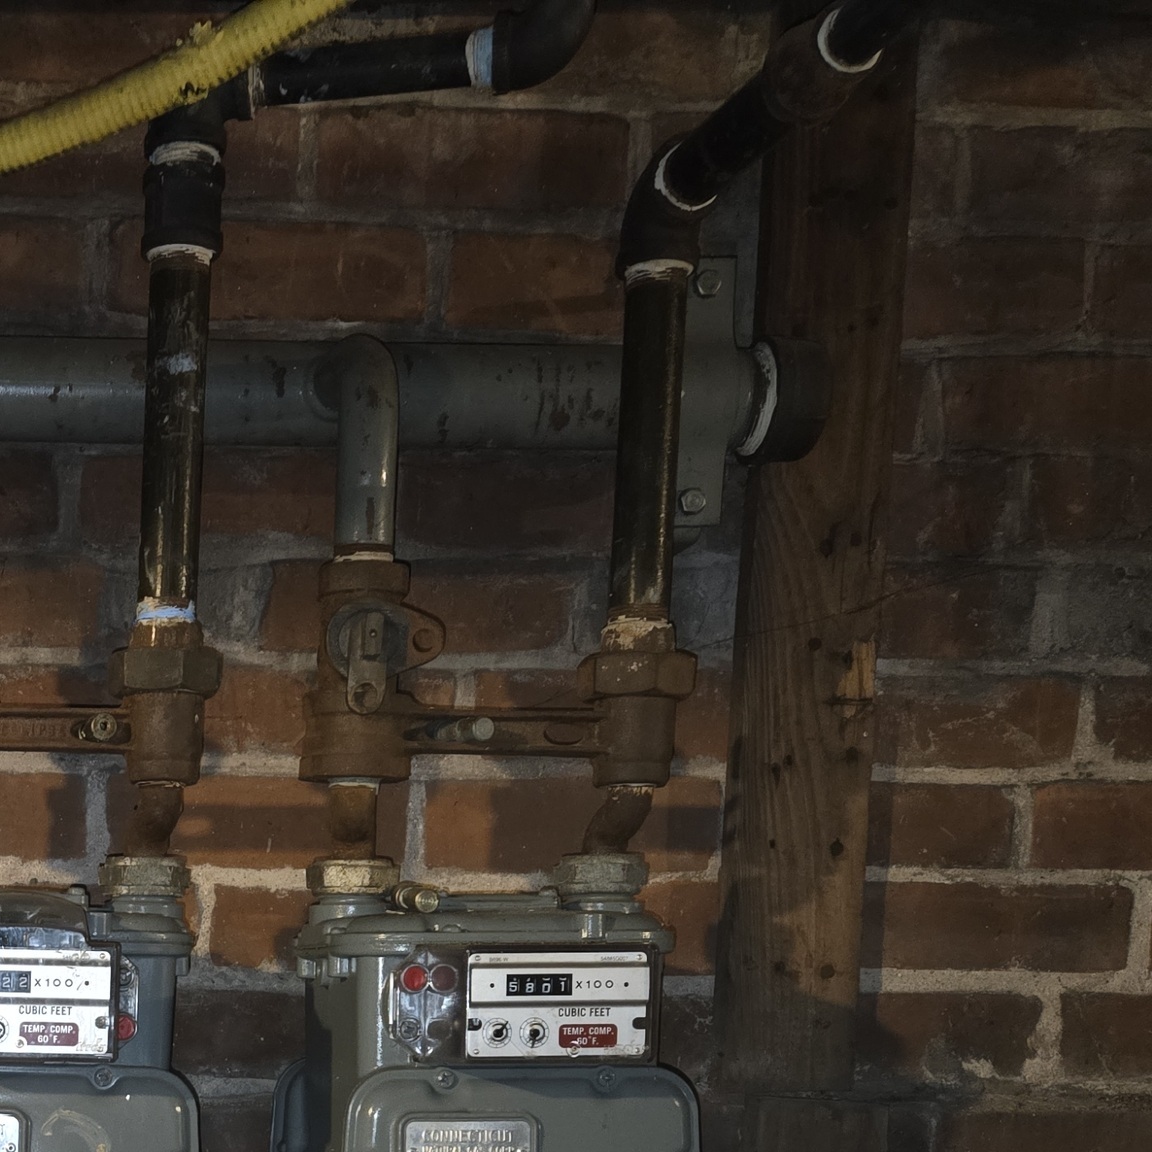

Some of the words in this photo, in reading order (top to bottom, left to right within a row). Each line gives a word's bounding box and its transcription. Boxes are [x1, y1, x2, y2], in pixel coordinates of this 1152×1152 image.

[19, 1005, 48, 1015] CUBIC
[51, 1006, 72, 1016] FEET
[558, 1007, 586, 1017] CUBIC
[589, 1007, 611, 1016] FEET
[22, 1024, 47, 1033] TEMP.
[50, 1025, 76, 1034] COMP.
[562, 1027, 586, 1035] TEMP.
[589, 1027, 614, 1035] COMP.
